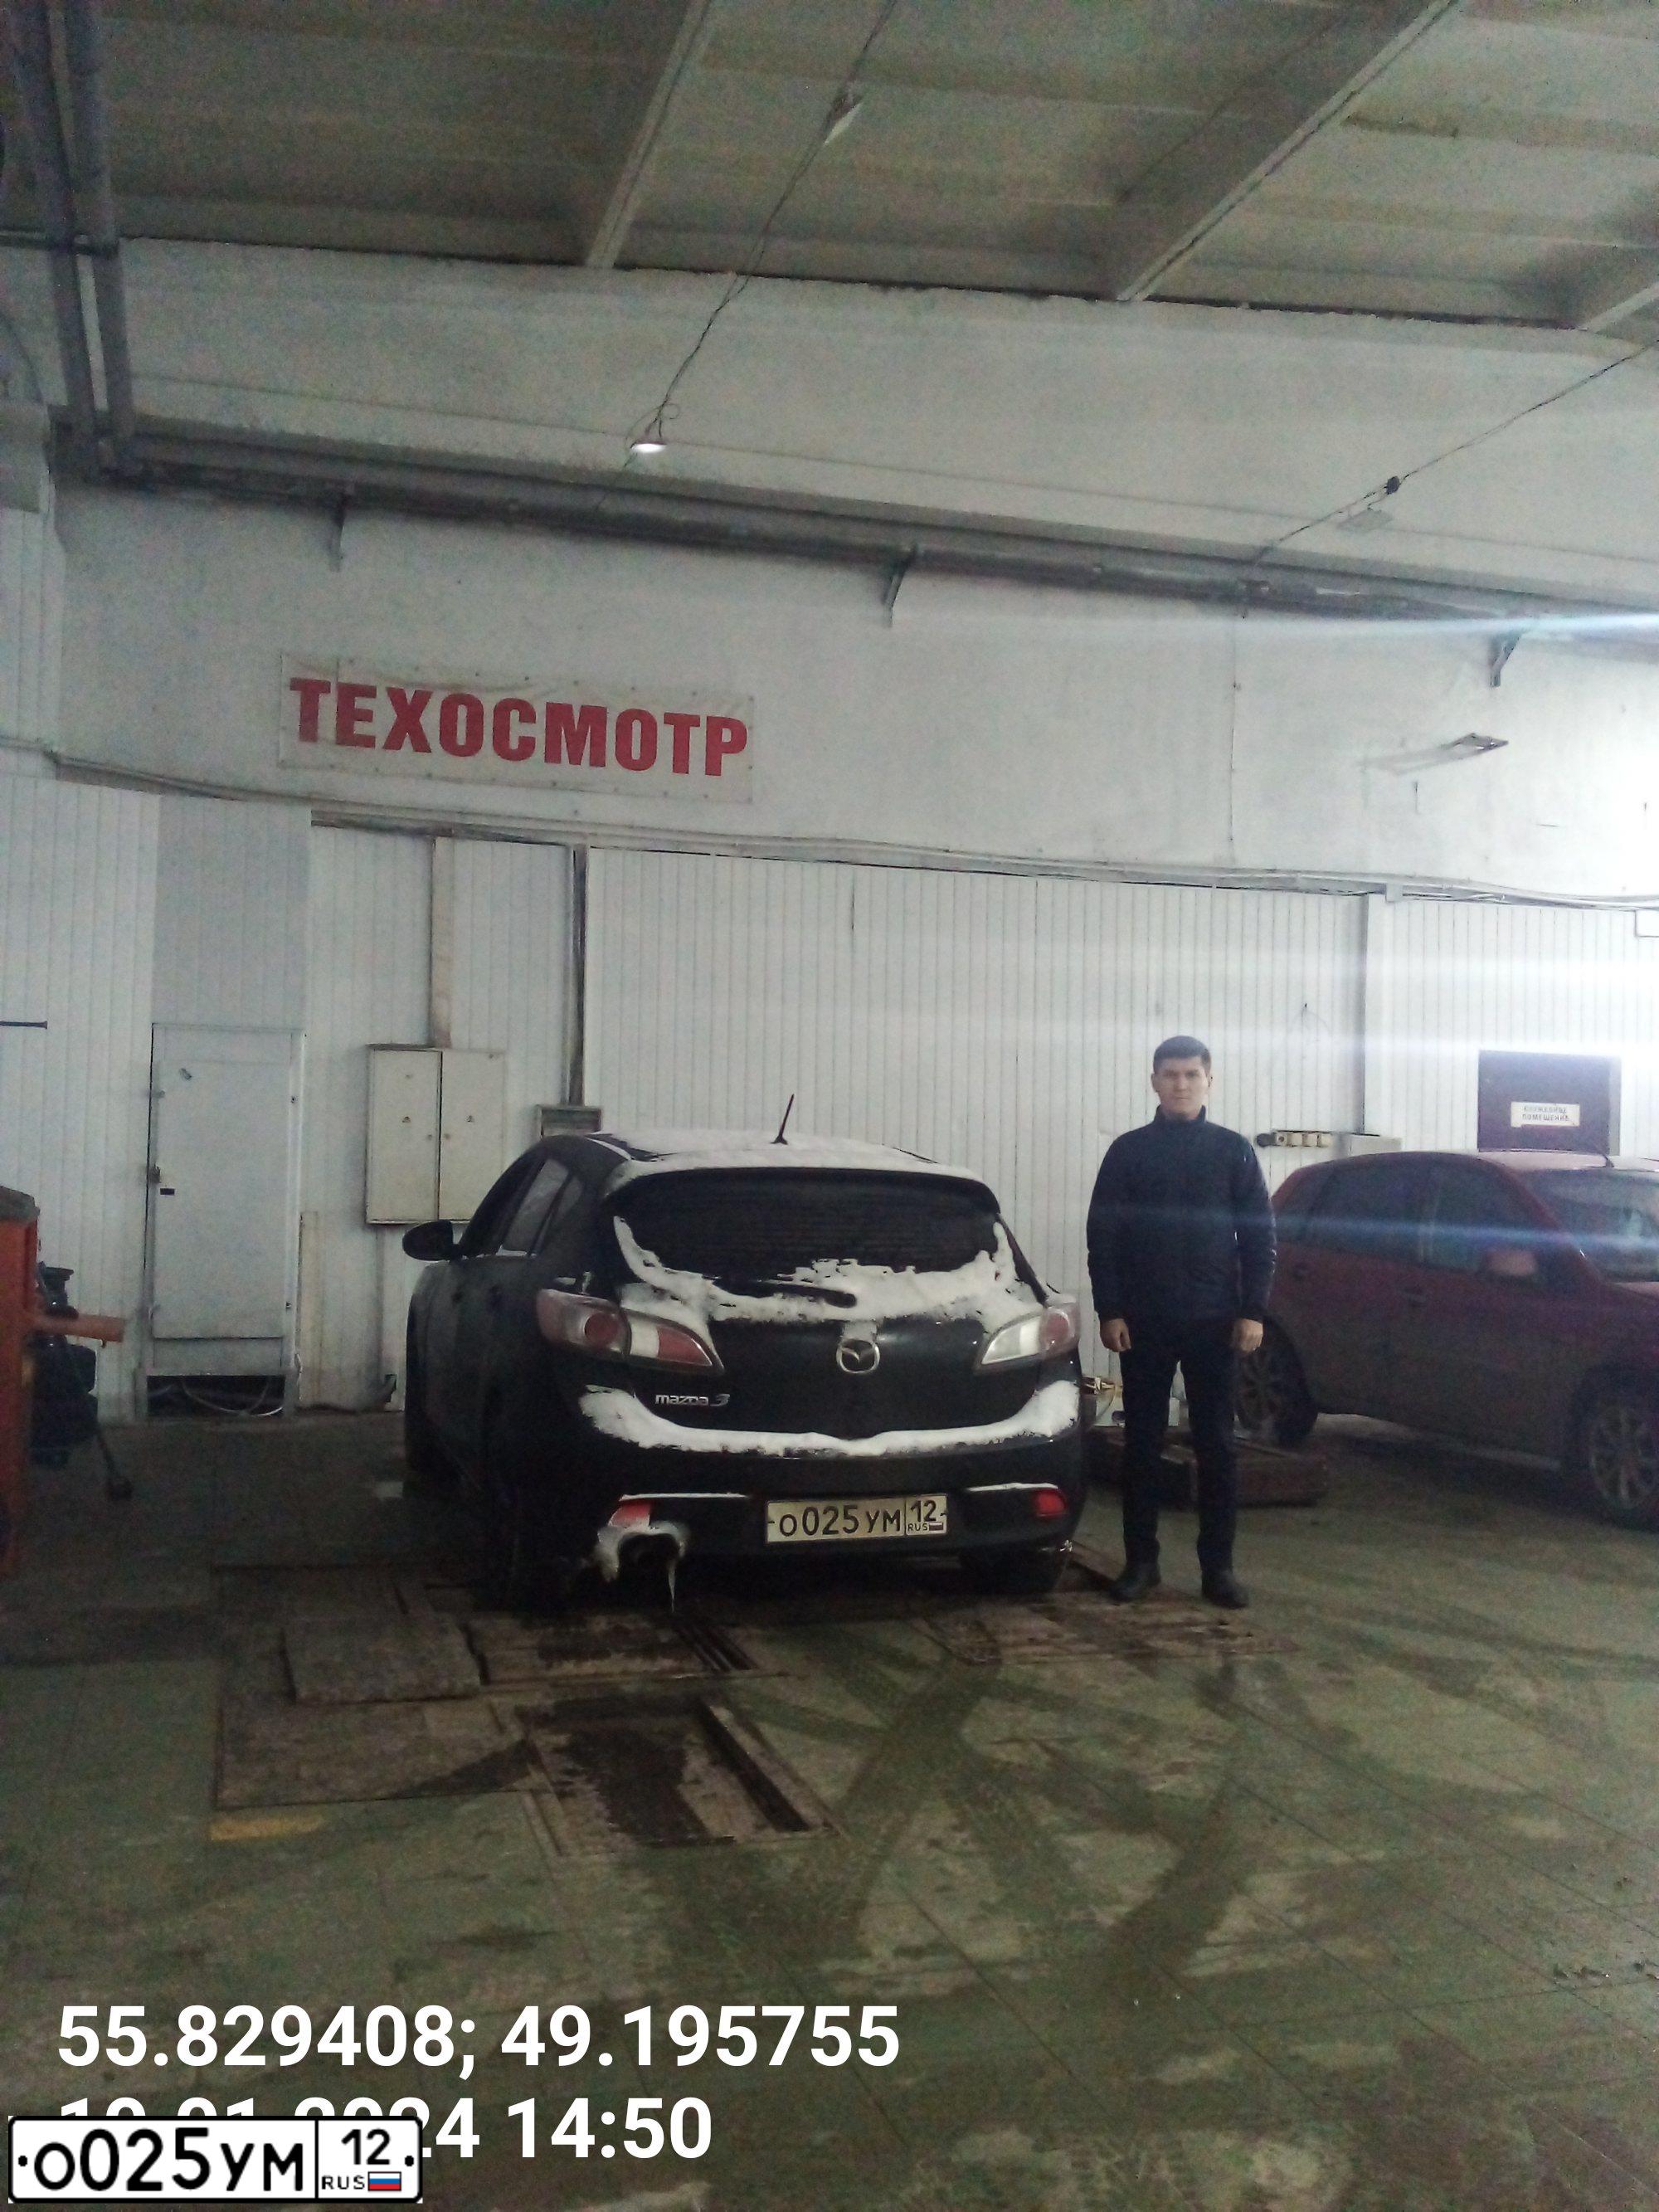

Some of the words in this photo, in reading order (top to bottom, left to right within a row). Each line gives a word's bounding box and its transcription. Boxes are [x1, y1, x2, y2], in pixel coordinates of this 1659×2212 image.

[289, 677, 748, 777] ТЕХОСМОТР
[654, 1394, 709, 1406] mazda
[910, 1500, 937, 1523] 12
[907, 1523, 928, 1532] RUS
